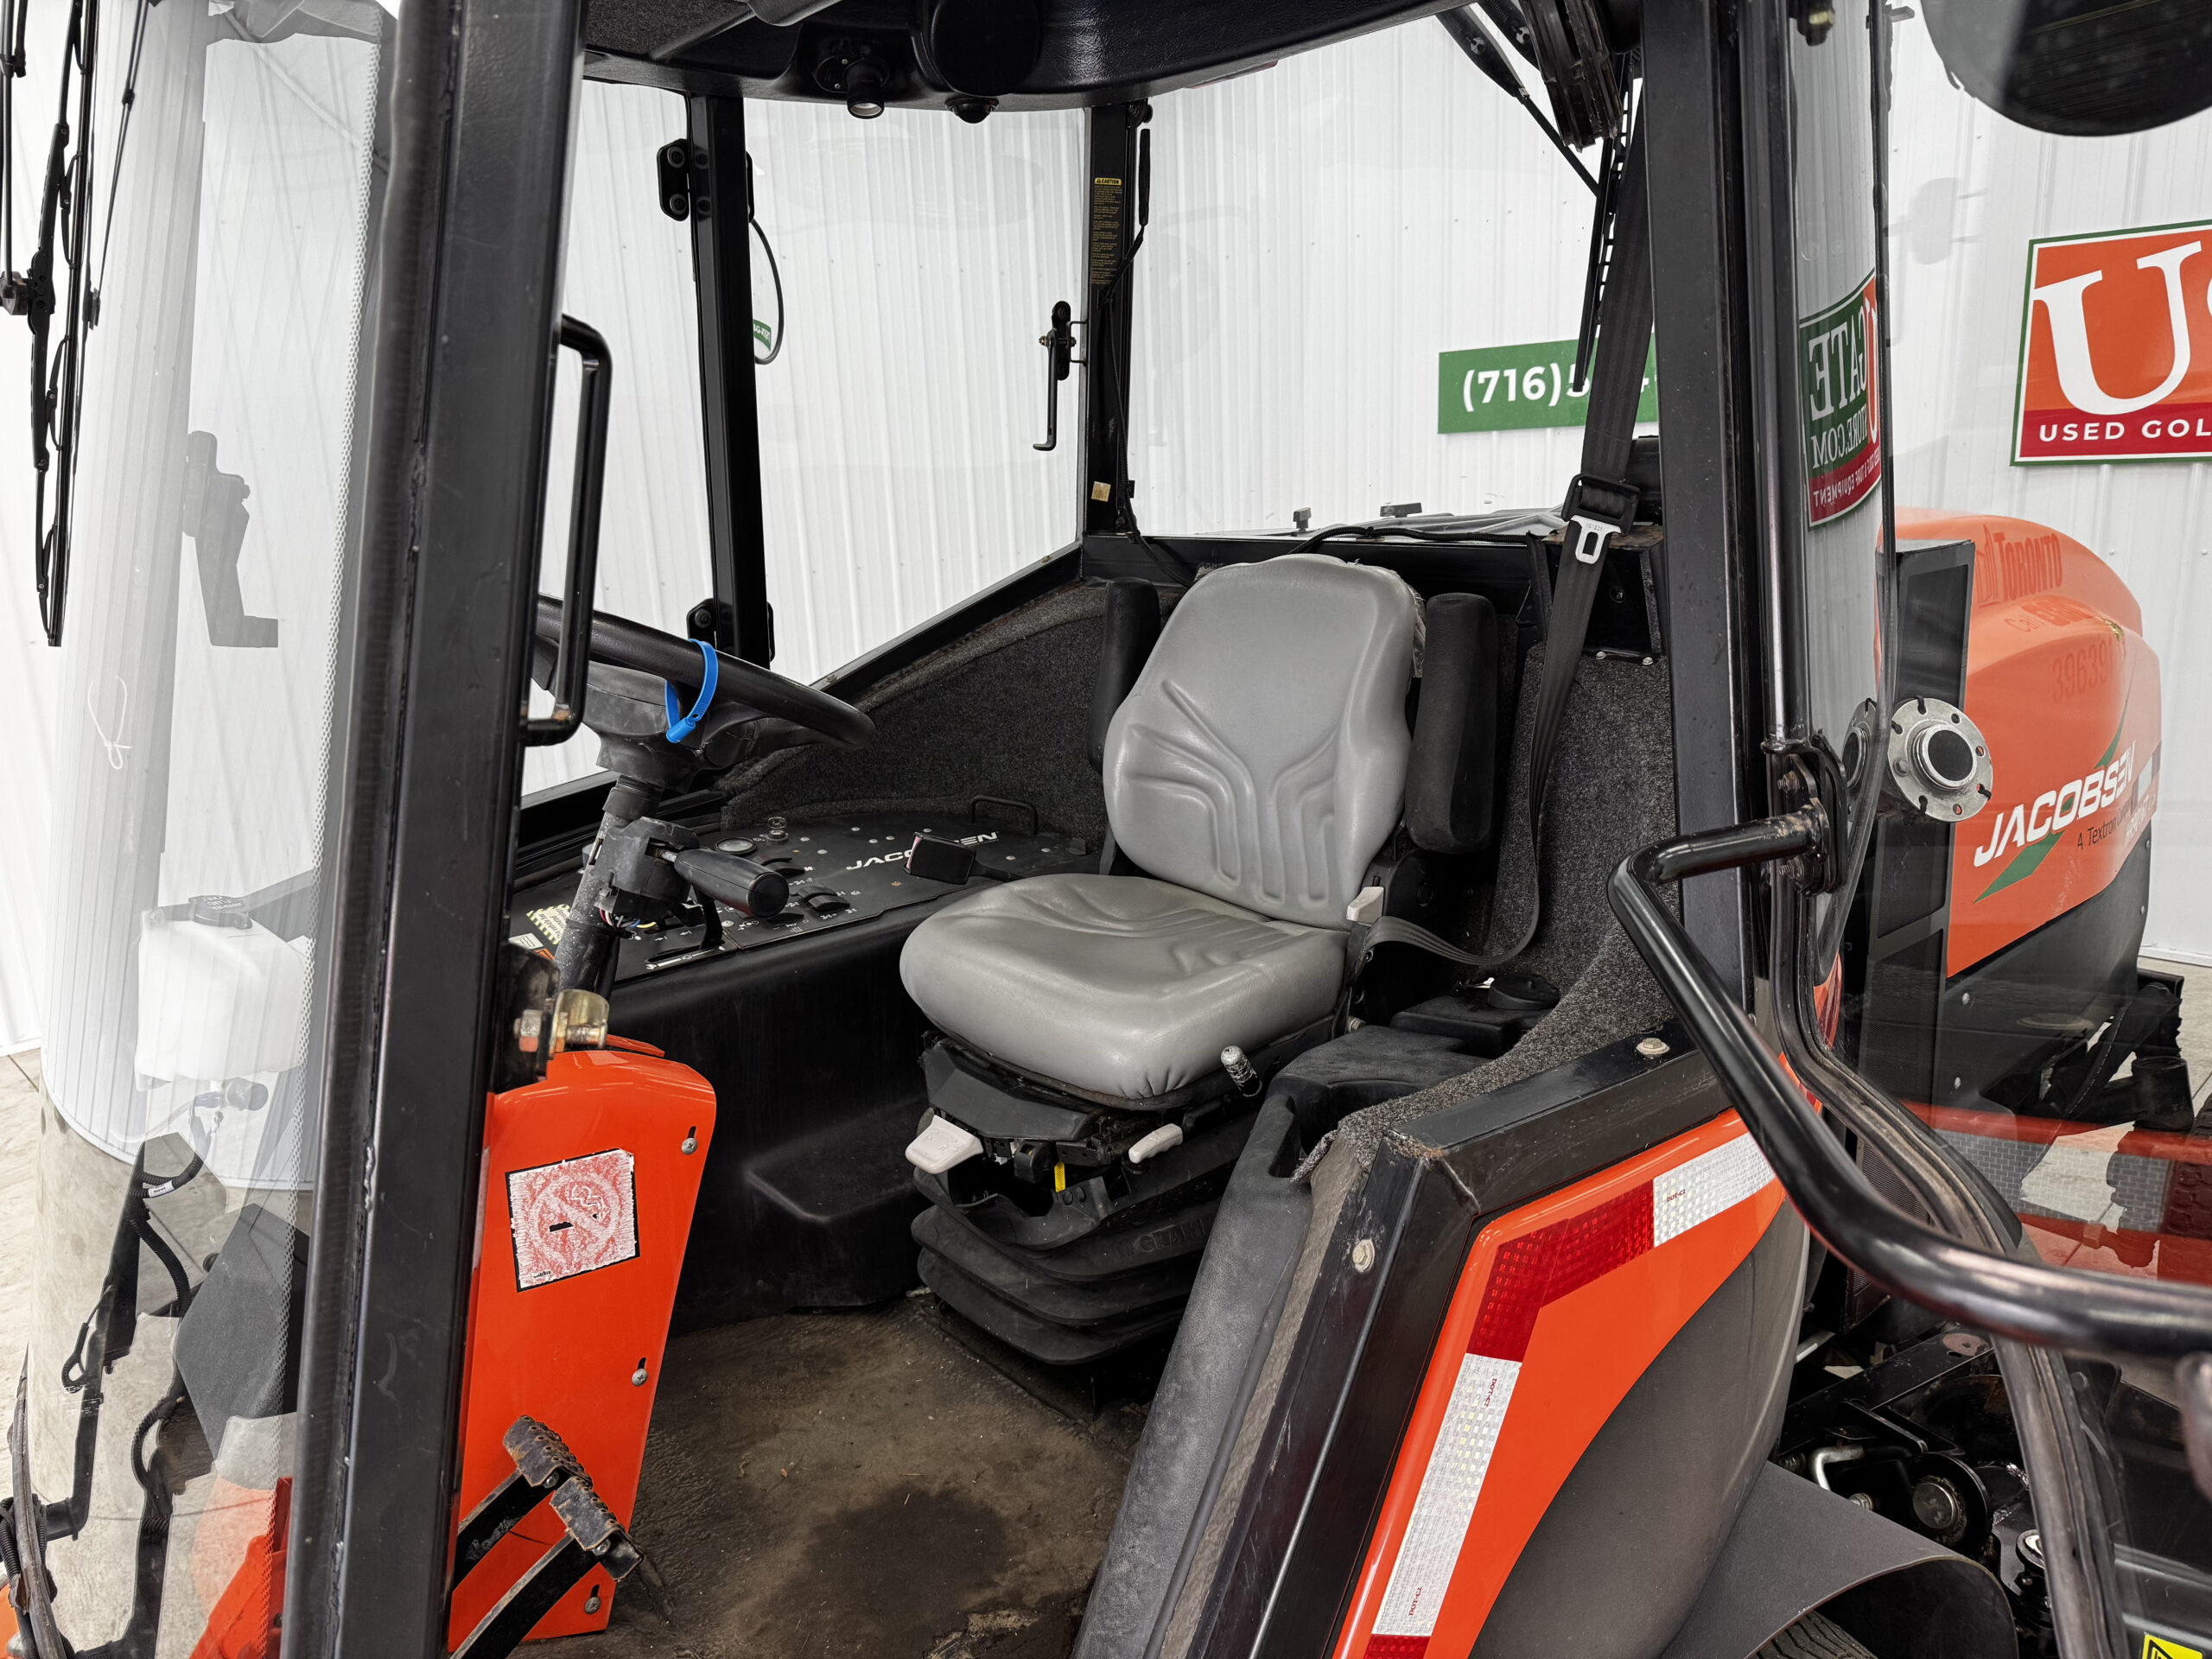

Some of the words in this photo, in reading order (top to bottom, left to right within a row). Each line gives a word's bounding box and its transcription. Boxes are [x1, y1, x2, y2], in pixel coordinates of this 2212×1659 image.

[2031, 239, 2212, 416] U
[2038, 422, 2126, 442] USED
[2140, 417, 2212, 439] GOL
[1974, 740, 2137, 868] JACOBSEN
